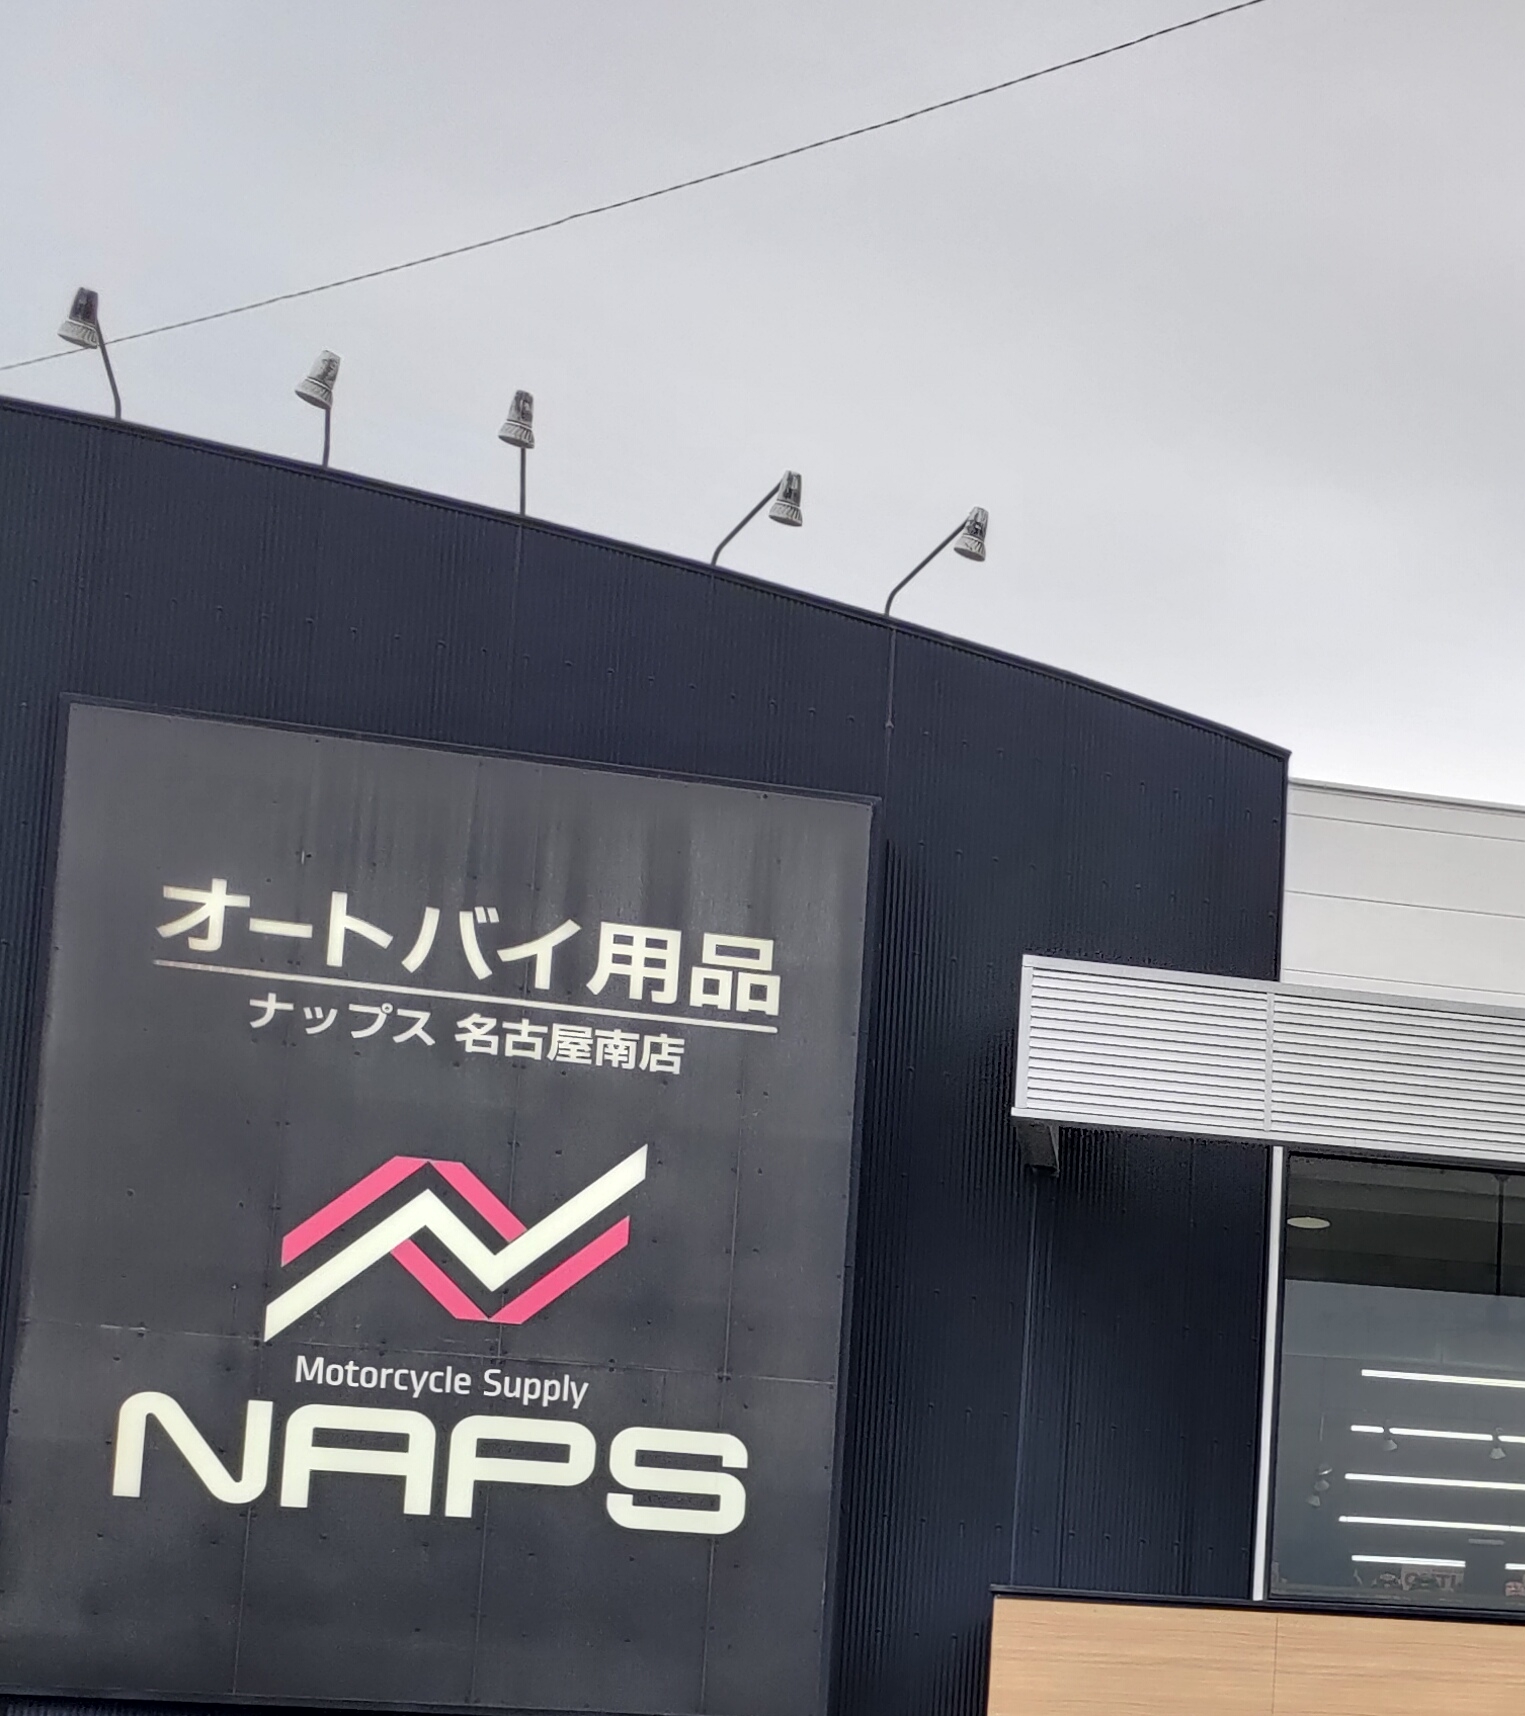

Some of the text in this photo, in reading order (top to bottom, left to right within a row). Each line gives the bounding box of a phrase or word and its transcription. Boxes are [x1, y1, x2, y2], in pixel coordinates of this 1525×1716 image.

[155, 878, 781, 1017] オートバイ用品
[248, 994, 685, 1075] ナップス 名古屋南店
[294, 1356, 589, 1409] Motorcycle Supply
[112, 1391, 748, 1535] NAPS
